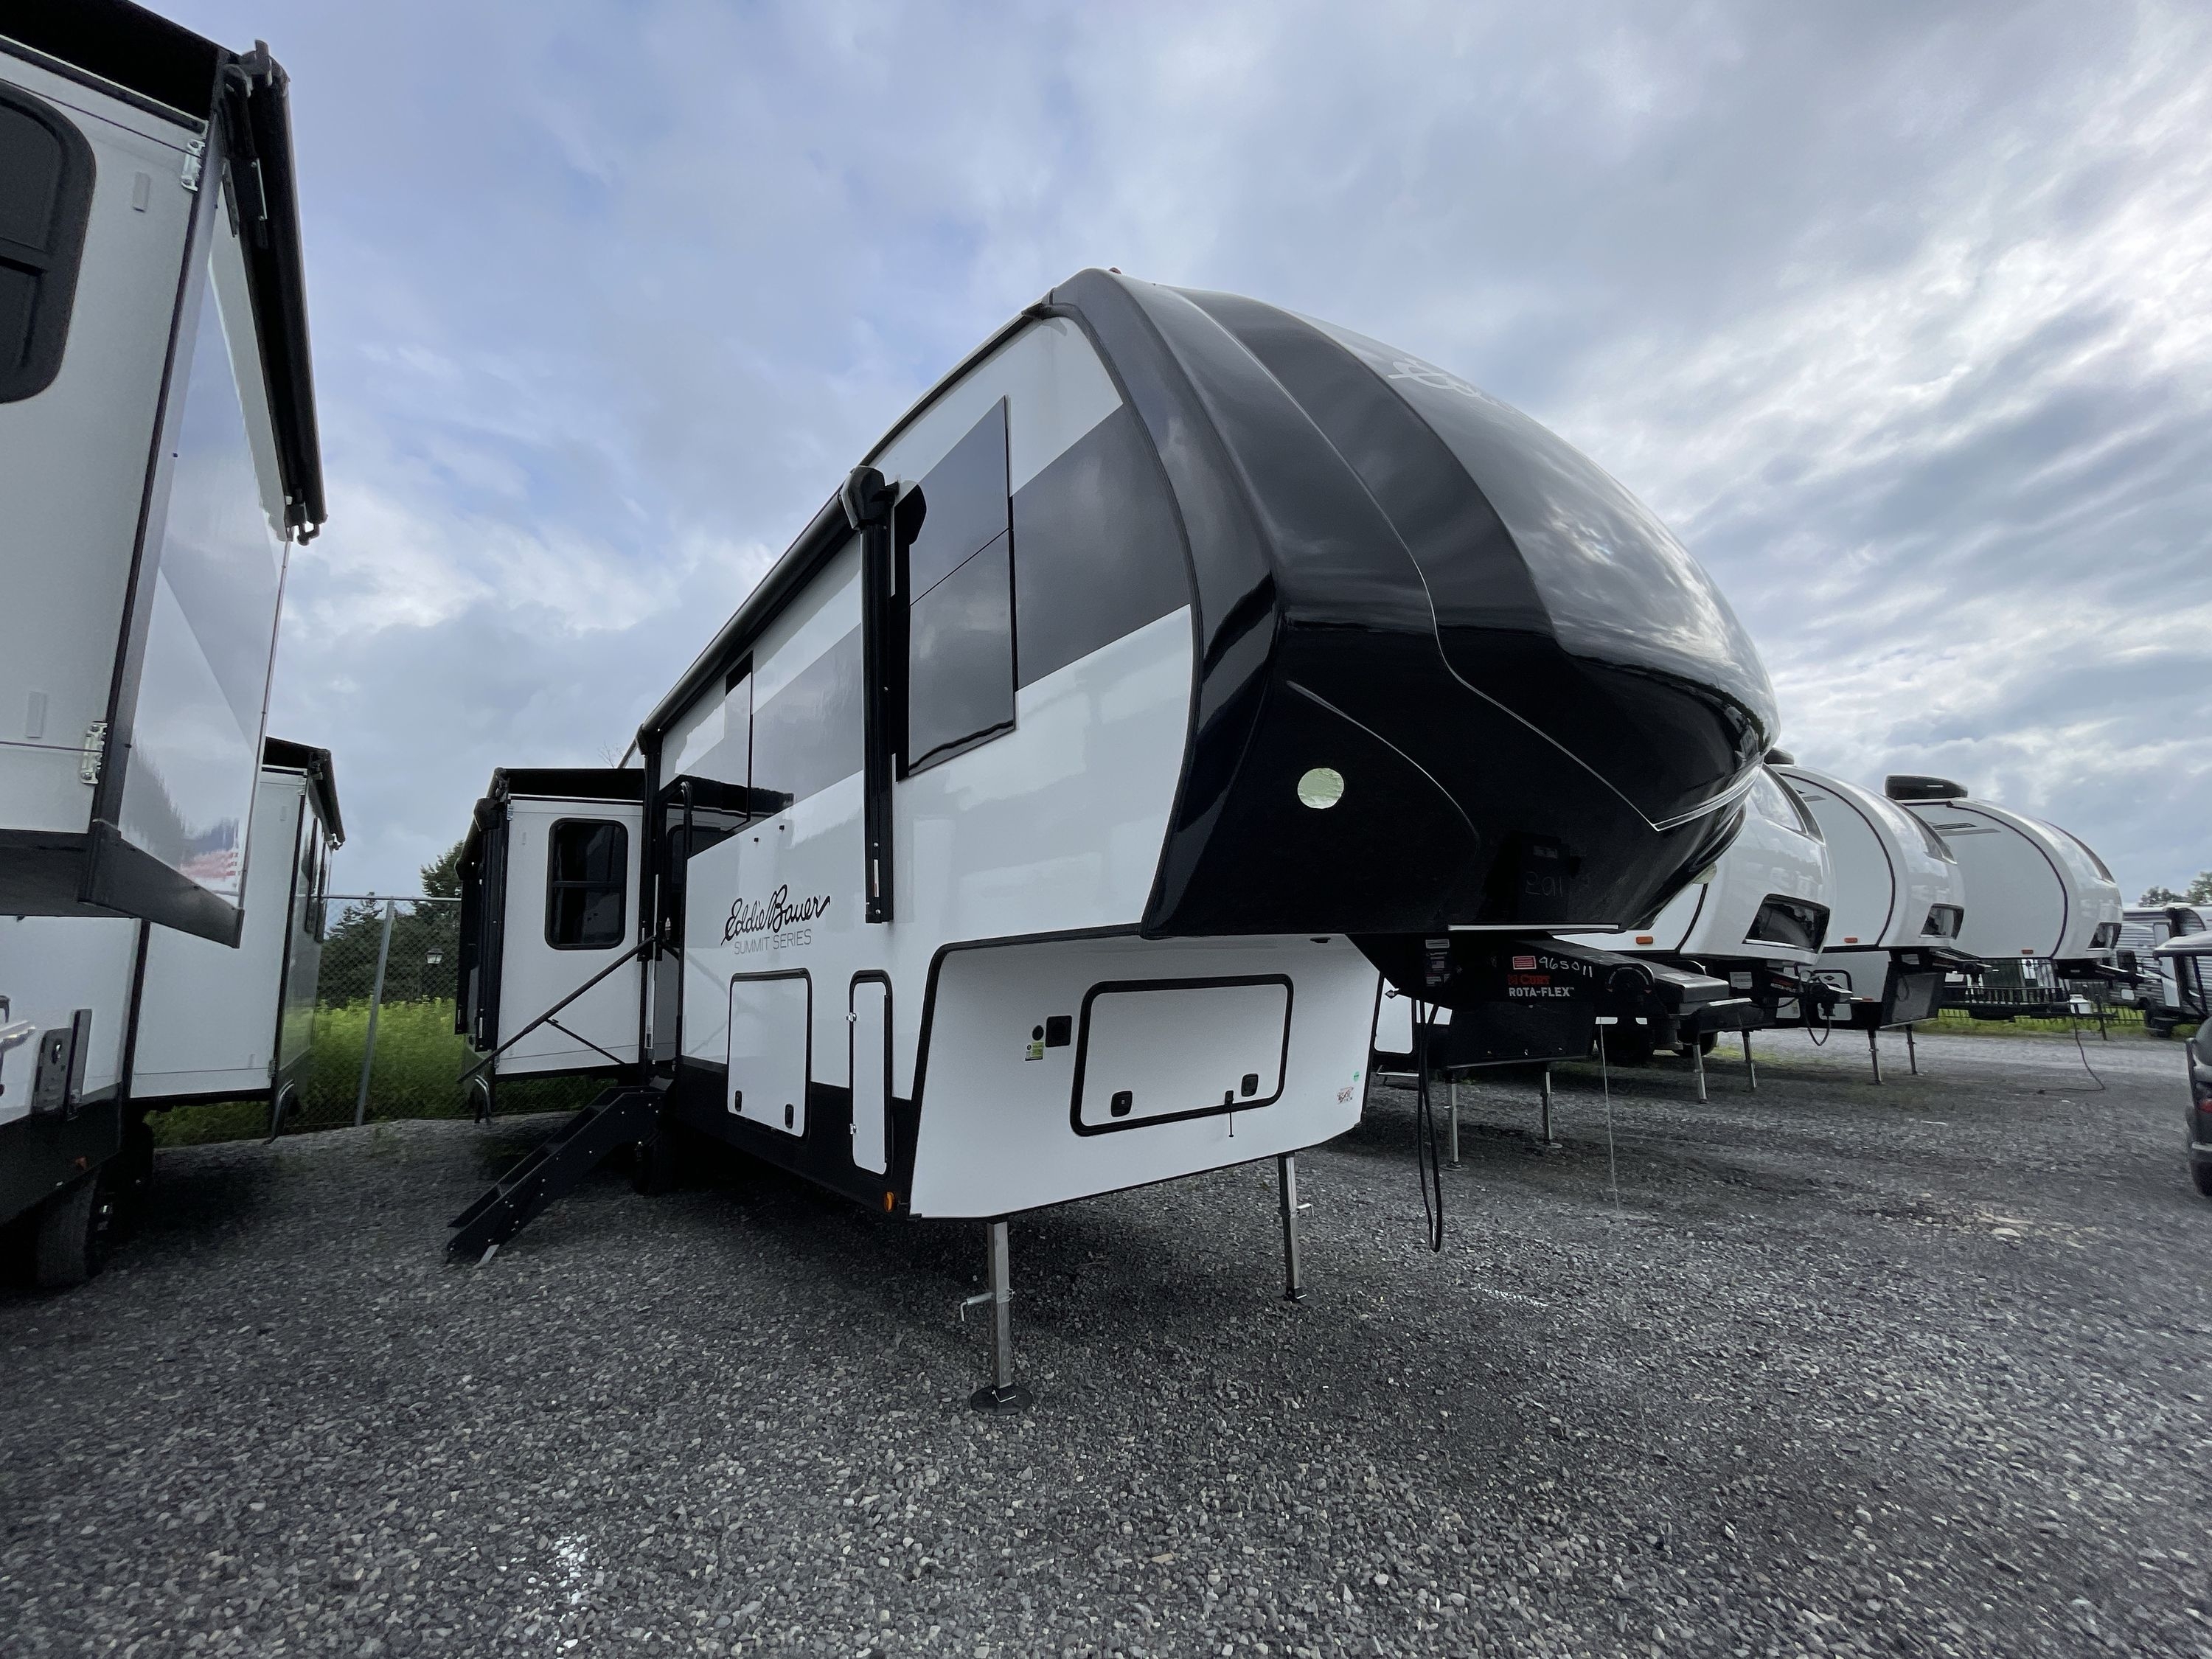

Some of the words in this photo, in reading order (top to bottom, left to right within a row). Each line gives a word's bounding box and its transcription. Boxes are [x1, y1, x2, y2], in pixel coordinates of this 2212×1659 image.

[720, 897, 768, 946] Eddie
[766, 884, 831, 933] Bauer
[734, 936, 770, 955] SUMMIT
[773, 929, 812, 950] SERIES
[1539, 956, 1593, 978] 965011
